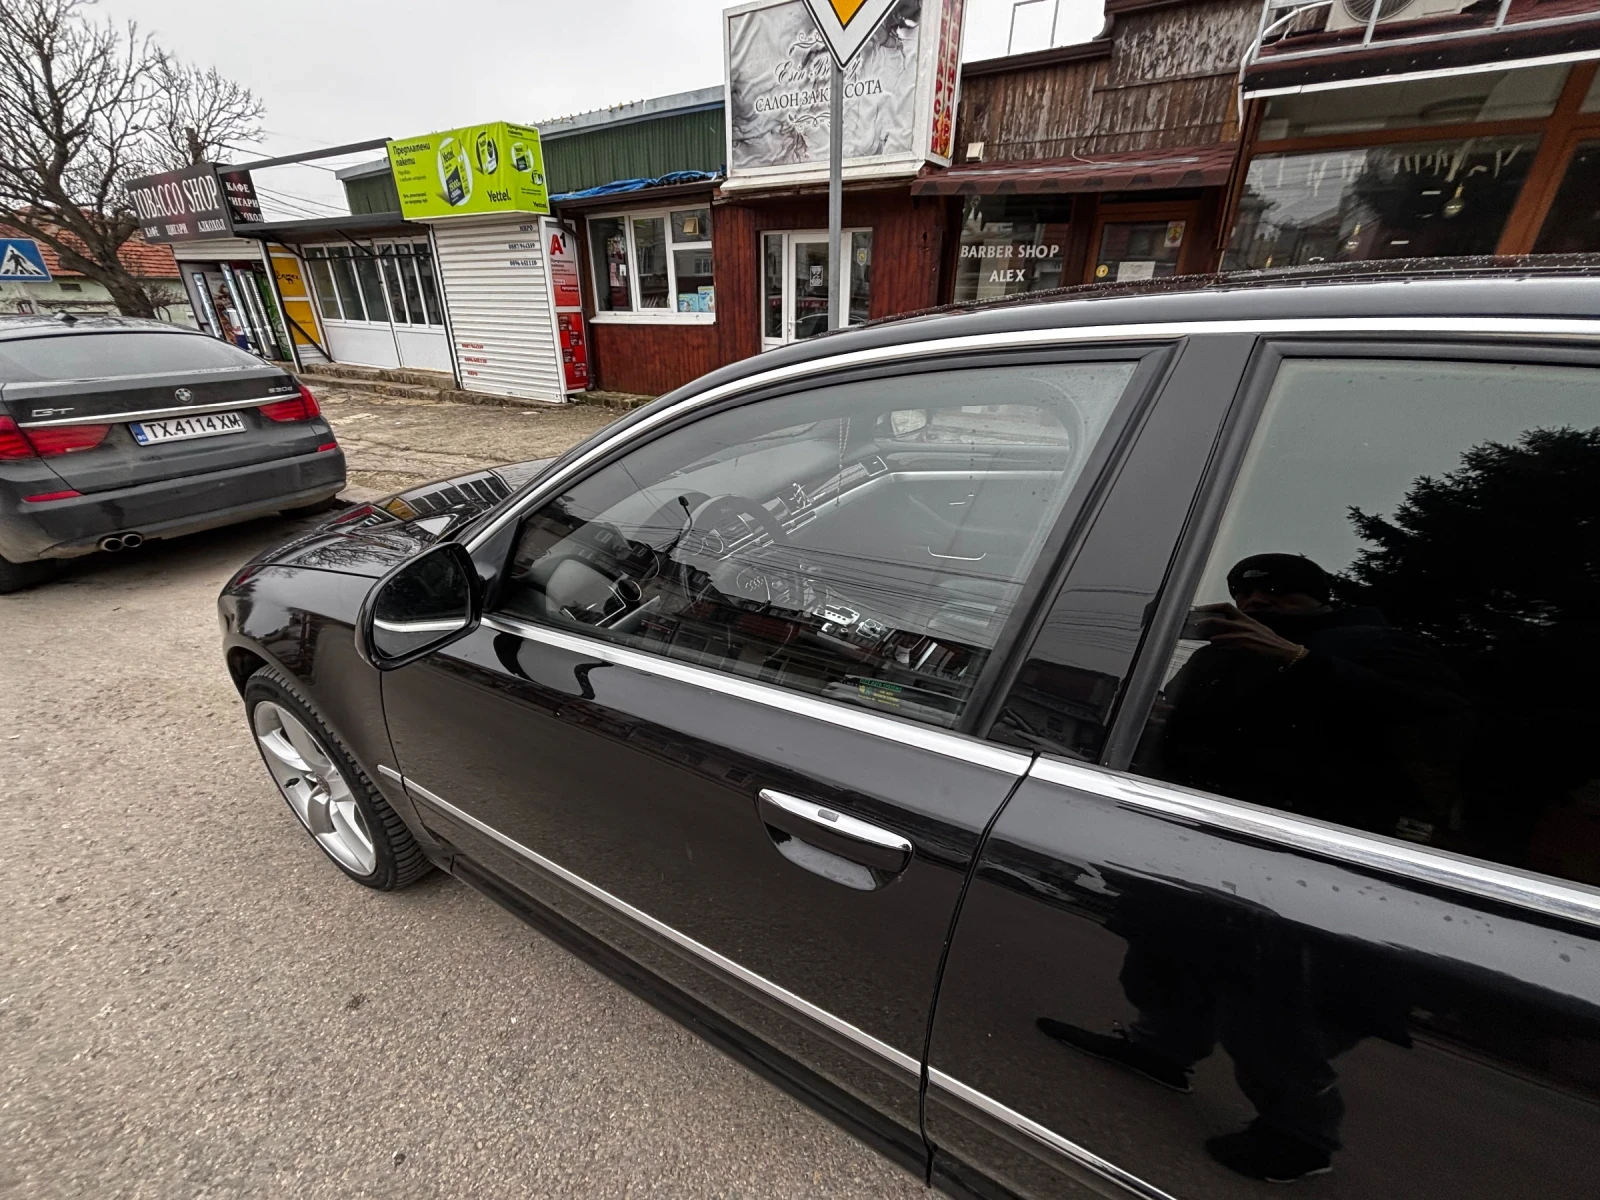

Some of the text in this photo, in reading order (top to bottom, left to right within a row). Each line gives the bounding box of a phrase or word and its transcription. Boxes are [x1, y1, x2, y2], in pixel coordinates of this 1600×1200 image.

[755, 78, 883, 112] САЛОН ЗА КСОТА
[225, 181, 250, 193] КАФЕ
[131, 175, 220, 220] TOBACCO SHOP
[228, 196, 260, 208] ИГАРИ
[144, 227, 160, 237] КАФЕ
[550, 232, 567, 255] A1
[960, 244, 1060, 259] BARBER SHOP
[989, 268, 1027, 283] ALEX
